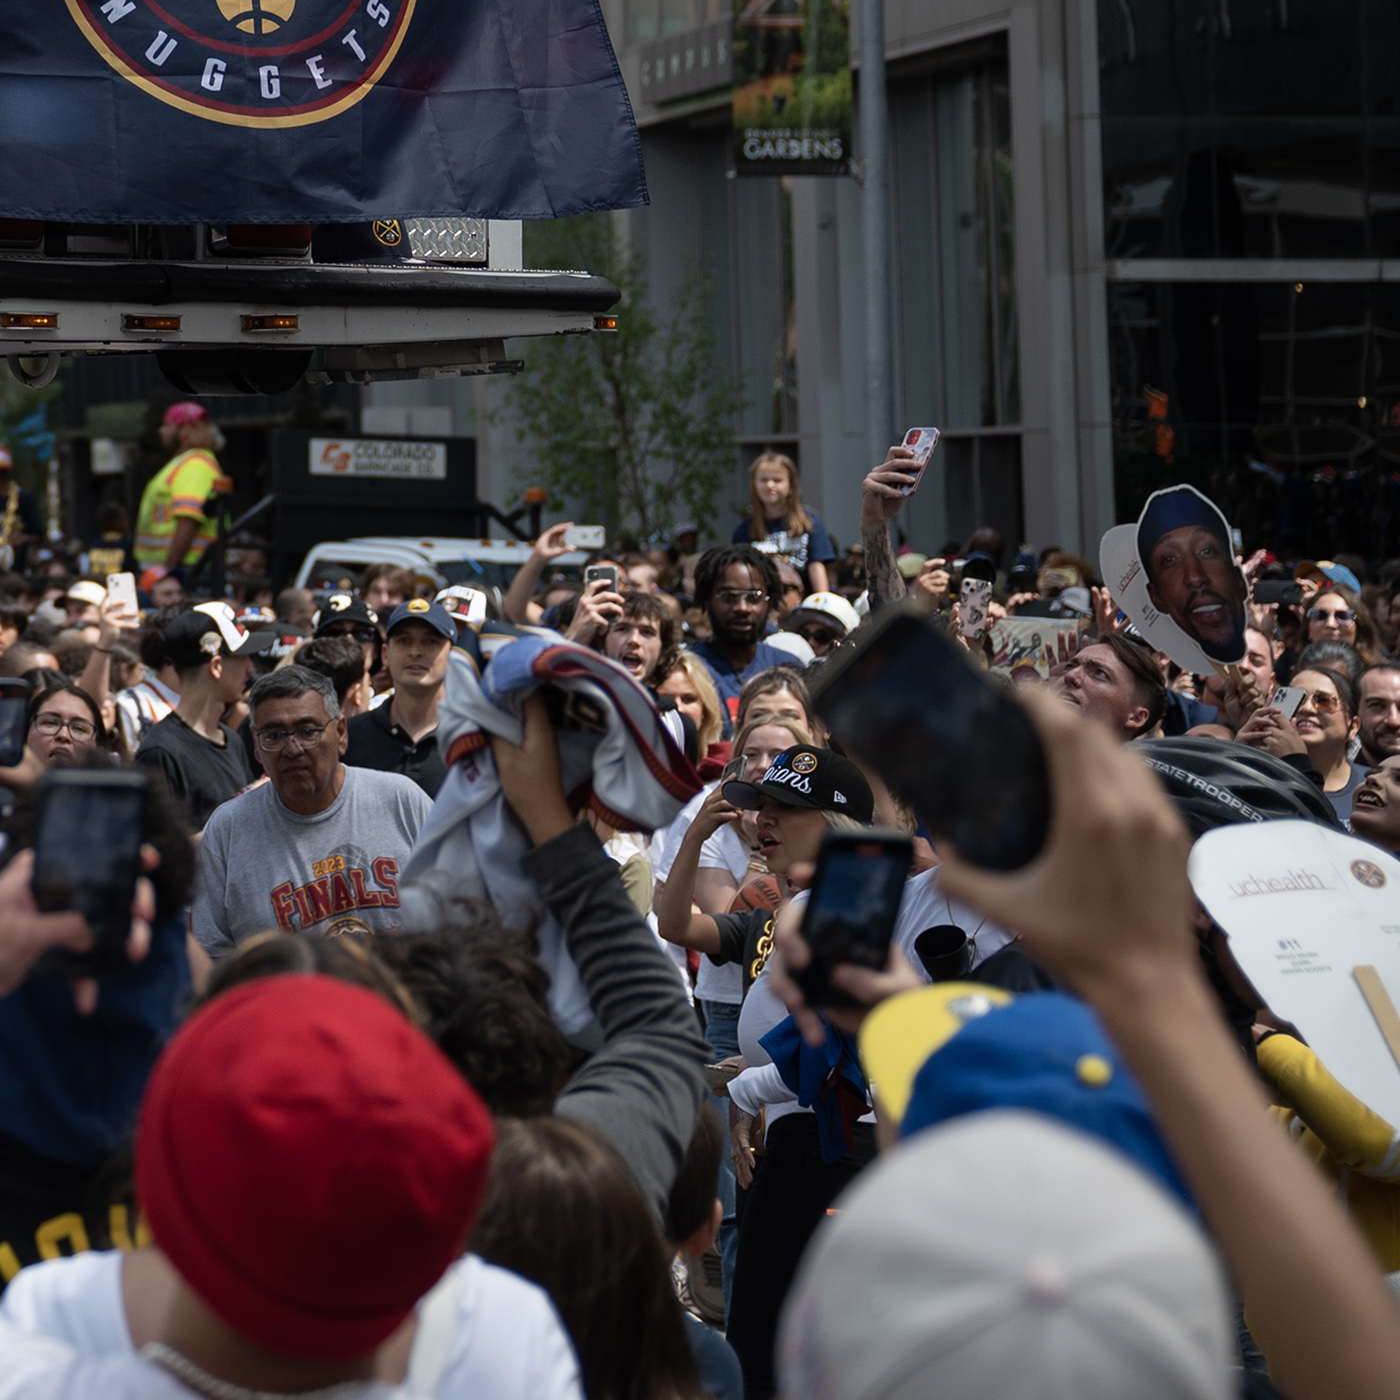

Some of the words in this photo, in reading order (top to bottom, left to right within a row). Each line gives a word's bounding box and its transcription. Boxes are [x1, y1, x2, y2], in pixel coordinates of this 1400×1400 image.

[743, 138, 843, 160] GARDENS
[353, 441, 436, 462] COLORADO
[312, 854, 345, 878] 2023
[1227, 866, 1328, 898] uchealth
[270, 856, 400, 934] FINALS
